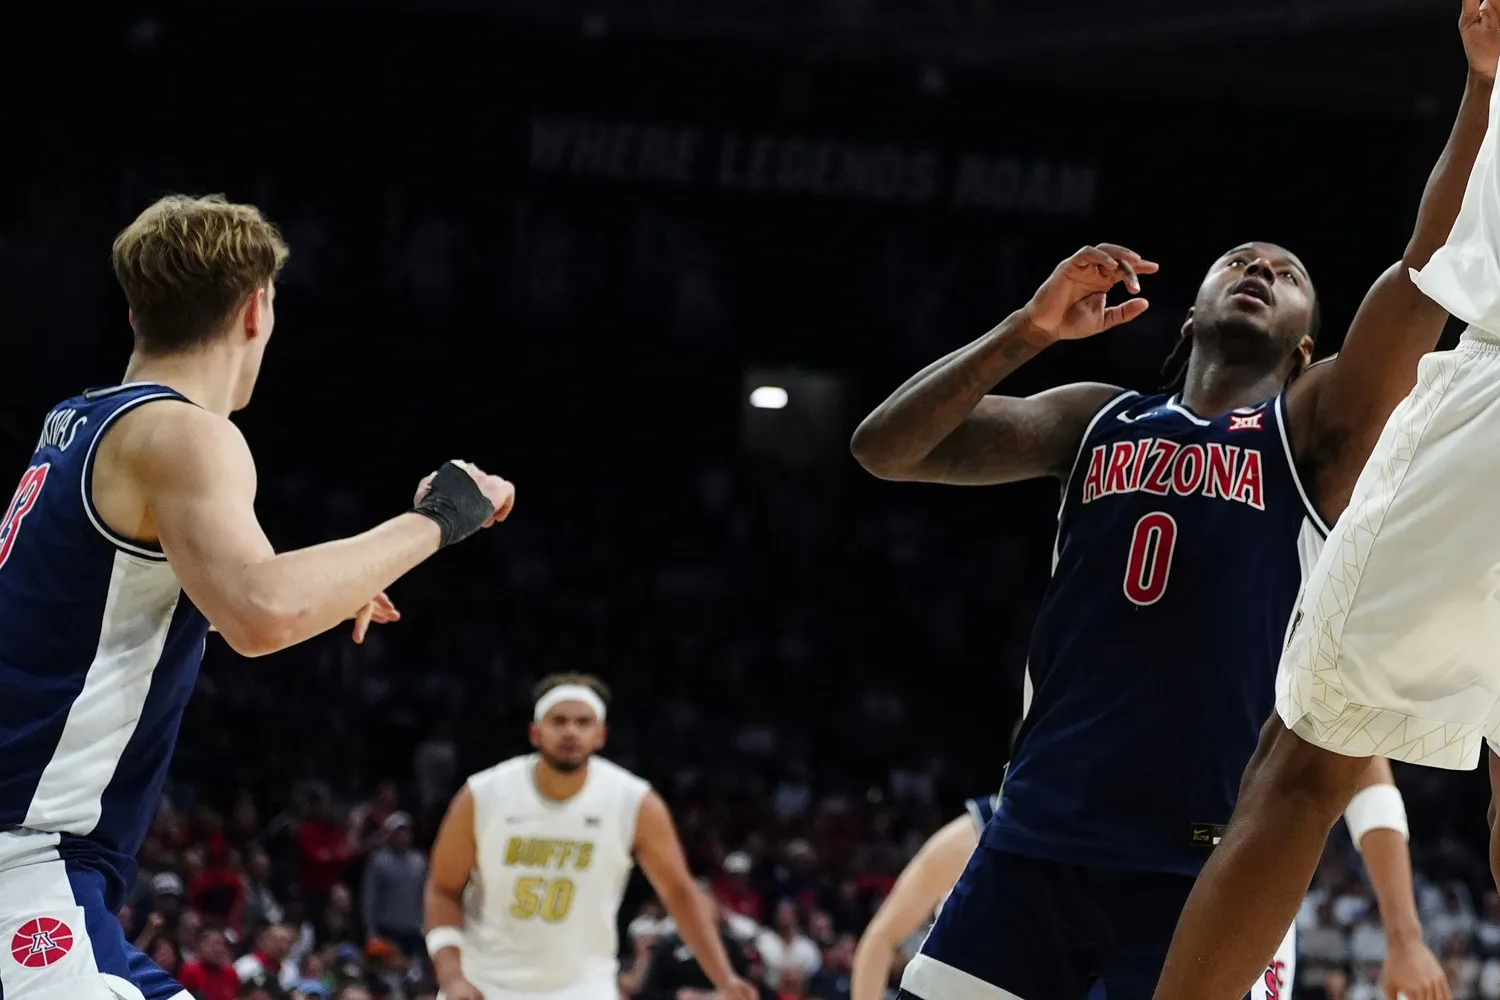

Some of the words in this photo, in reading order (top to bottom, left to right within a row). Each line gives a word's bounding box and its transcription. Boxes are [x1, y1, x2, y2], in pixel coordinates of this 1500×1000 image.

[529, 116, 701, 183] WHERE
[717, 132, 938, 203] LEGENDS
[952, 152, 1101, 217] ROAM
[1082, 438, 1265, 511] ARIZONA
[1123, 511, 1177, 606] 0
[504, 837, 596, 871] BUFFS
[511, 876, 575, 925] 50
[30, 932, 56, 953] A
